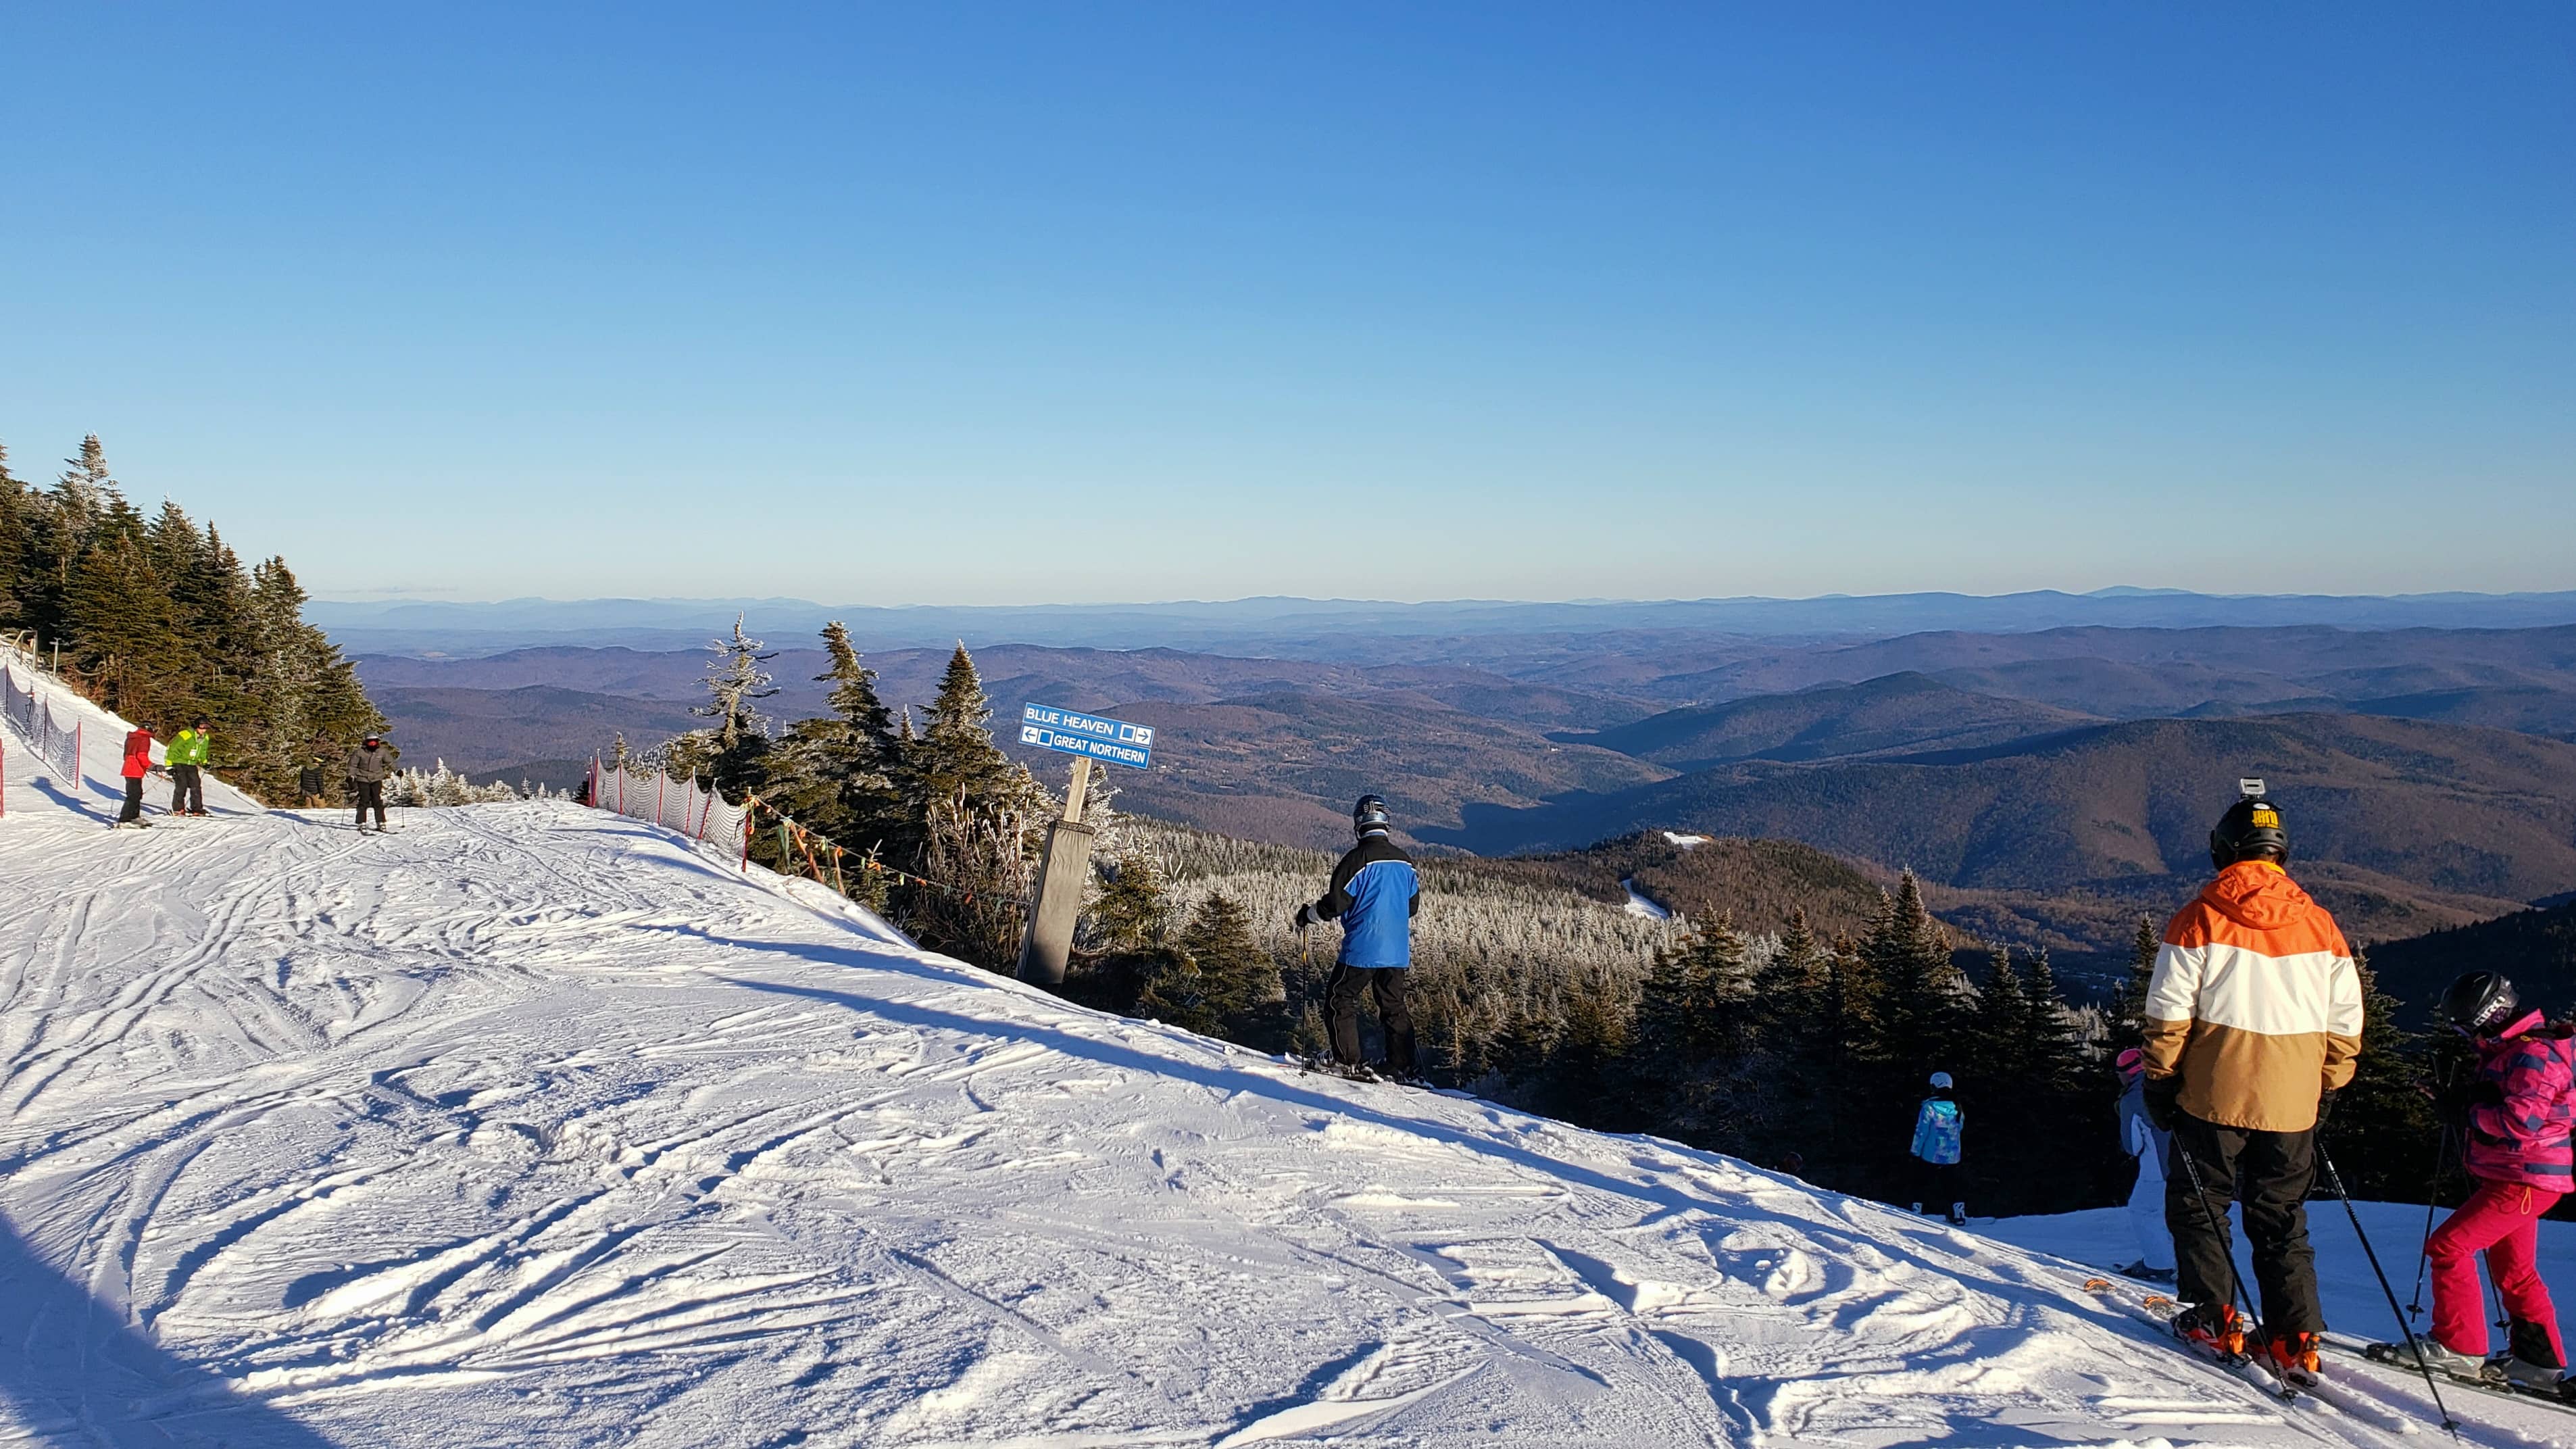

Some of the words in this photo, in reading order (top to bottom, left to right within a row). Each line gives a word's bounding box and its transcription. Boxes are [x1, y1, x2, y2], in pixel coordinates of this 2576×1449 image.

[1026, 708, 1060, 724] BLUE
[1063, 714, 1114, 735] HEAVEN
[1054, 735, 1089, 752] GREAT
[1089, 741, 1145, 764] NORTHERN
